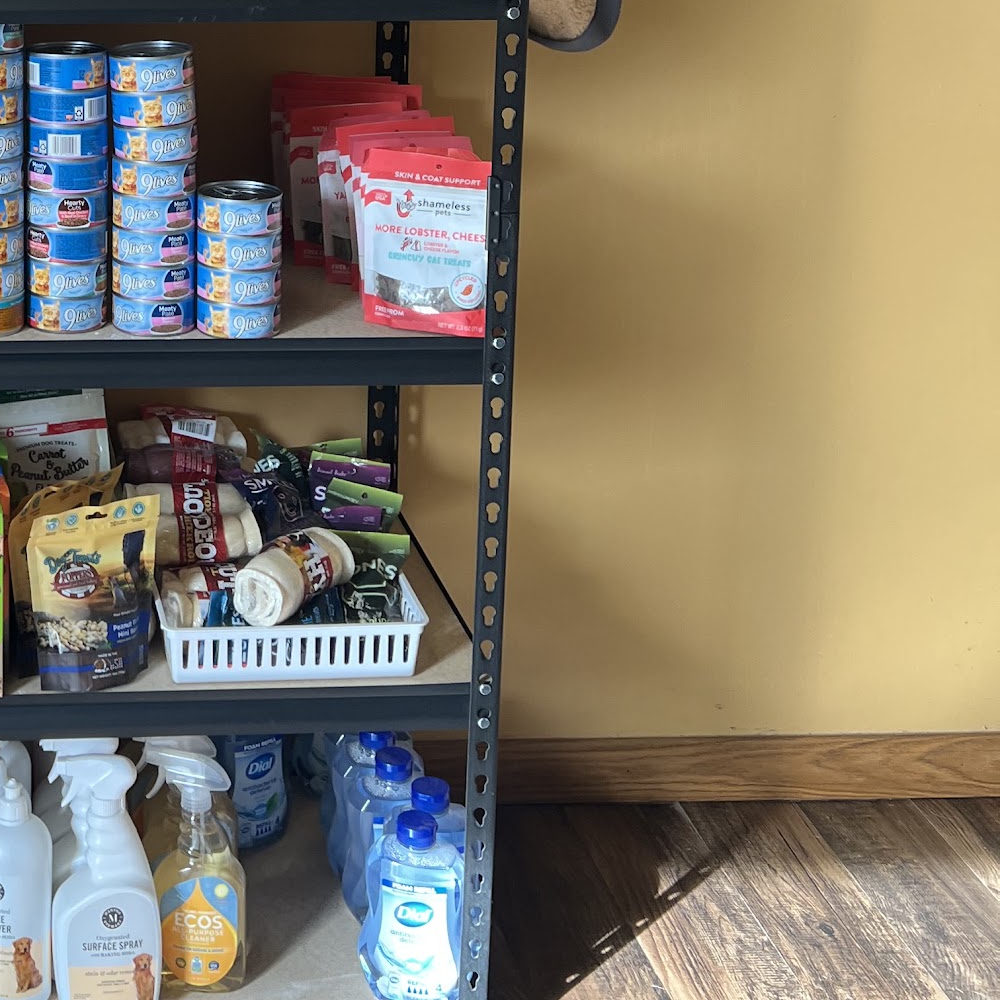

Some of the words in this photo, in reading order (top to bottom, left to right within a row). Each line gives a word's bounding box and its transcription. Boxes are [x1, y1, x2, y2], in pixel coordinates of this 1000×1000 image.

[394, 171, 414, 180] SKIN
[421, 174, 444, 182] COAT
[444, 176, 481, 187] SUPPORT
[417, 198, 471, 212] shameless
[434, 209, 451, 217] pets
[375, 223, 402, 234] MORE
[404, 226, 451, 241] LOBSTER,
[388, 251, 425, 262] CRUNCHY
[426, 255, 443, 265] CAT
[444, 257, 472, 268] TREATS
[158, 305, 176, 313] Meaty
[6, 426, 14, 437] 6
[28, 448, 67, 464] Carrot
[10, 463, 52, 481] Peanut
[53, 457, 89, 480] Butter
[113, 621, 133, 632] Peanut
[117, 629, 130, 638] Mini
[248, 757, 273, 775] Dial
[175, 913, 223, 930] ECOS
[397, 905, 433, 924] Dial
[172, 926, 224, 936] ALL-PURPOSE
[82, 941, 117, 951] SURFACE
[118, 939, 143, 950] SPRAY
